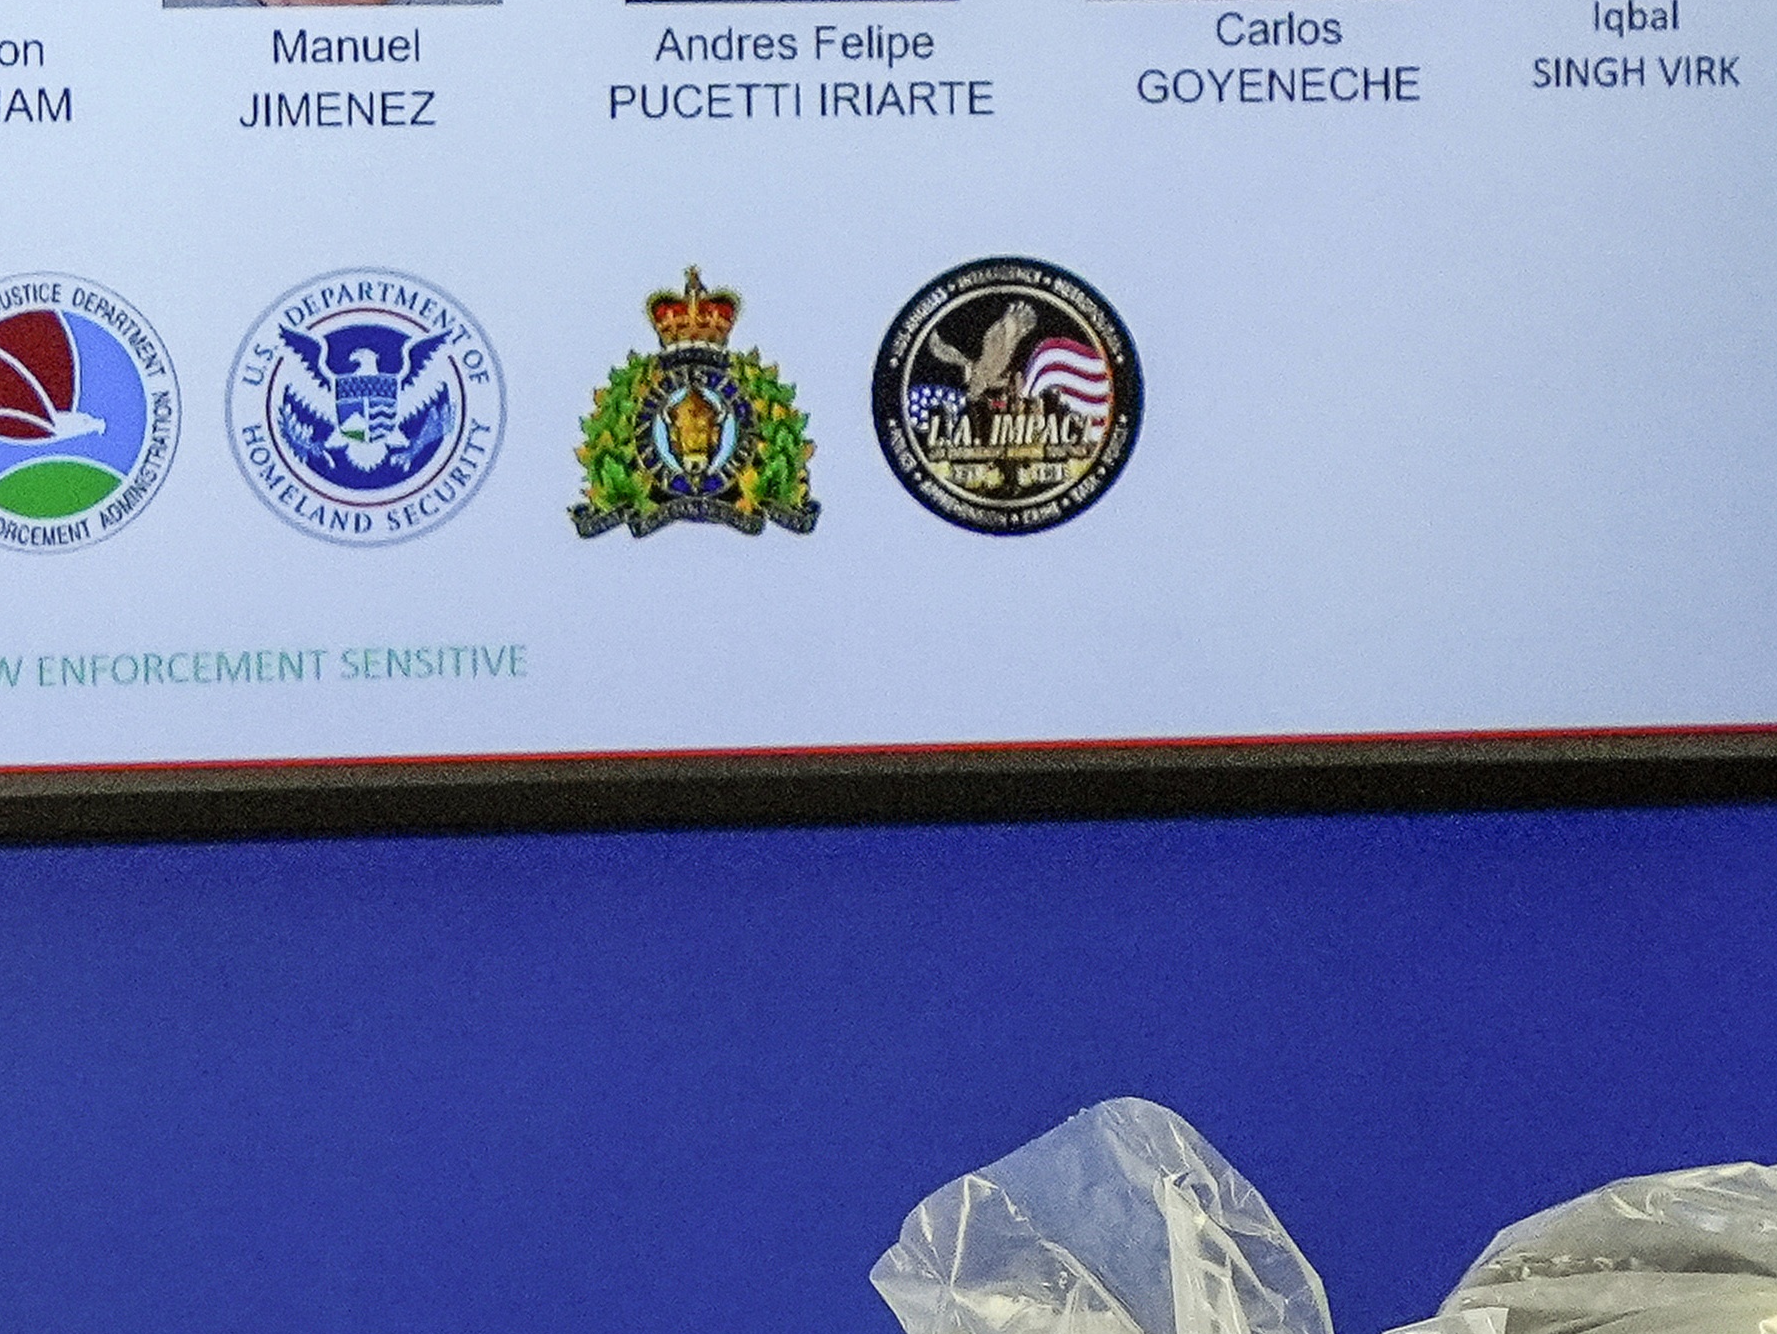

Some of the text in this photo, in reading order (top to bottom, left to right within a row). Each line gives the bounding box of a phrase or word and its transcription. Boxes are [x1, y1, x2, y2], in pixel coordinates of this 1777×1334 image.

[272, 27, 421, 65] Manuel
[654, 24, 935, 70] Andres Felipe
[1215, 10, 1344, 48] Carlos
[1136, 65, 1421, 105] GOYENECHE
[1532, 55, 1741, 89] SINGH VIRK
[238, 90, 437, 129] JIMENEZ
[609, 79, 995, 121] PUCETTI IRIARTE
[72, 287, 167, 378] DEPARTMENT
[283, 281, 472, 345] DEPARTMENT
[463, 349, 490, 385] OF
[99, 390, 172, 530] ADMINISTRATION
[242, 419, 492, 534] HOMELAND SECURITY
[37, 645, 326, 687] ENFORCEMENT
[337, 642, 529, 681] SENSITIVE
